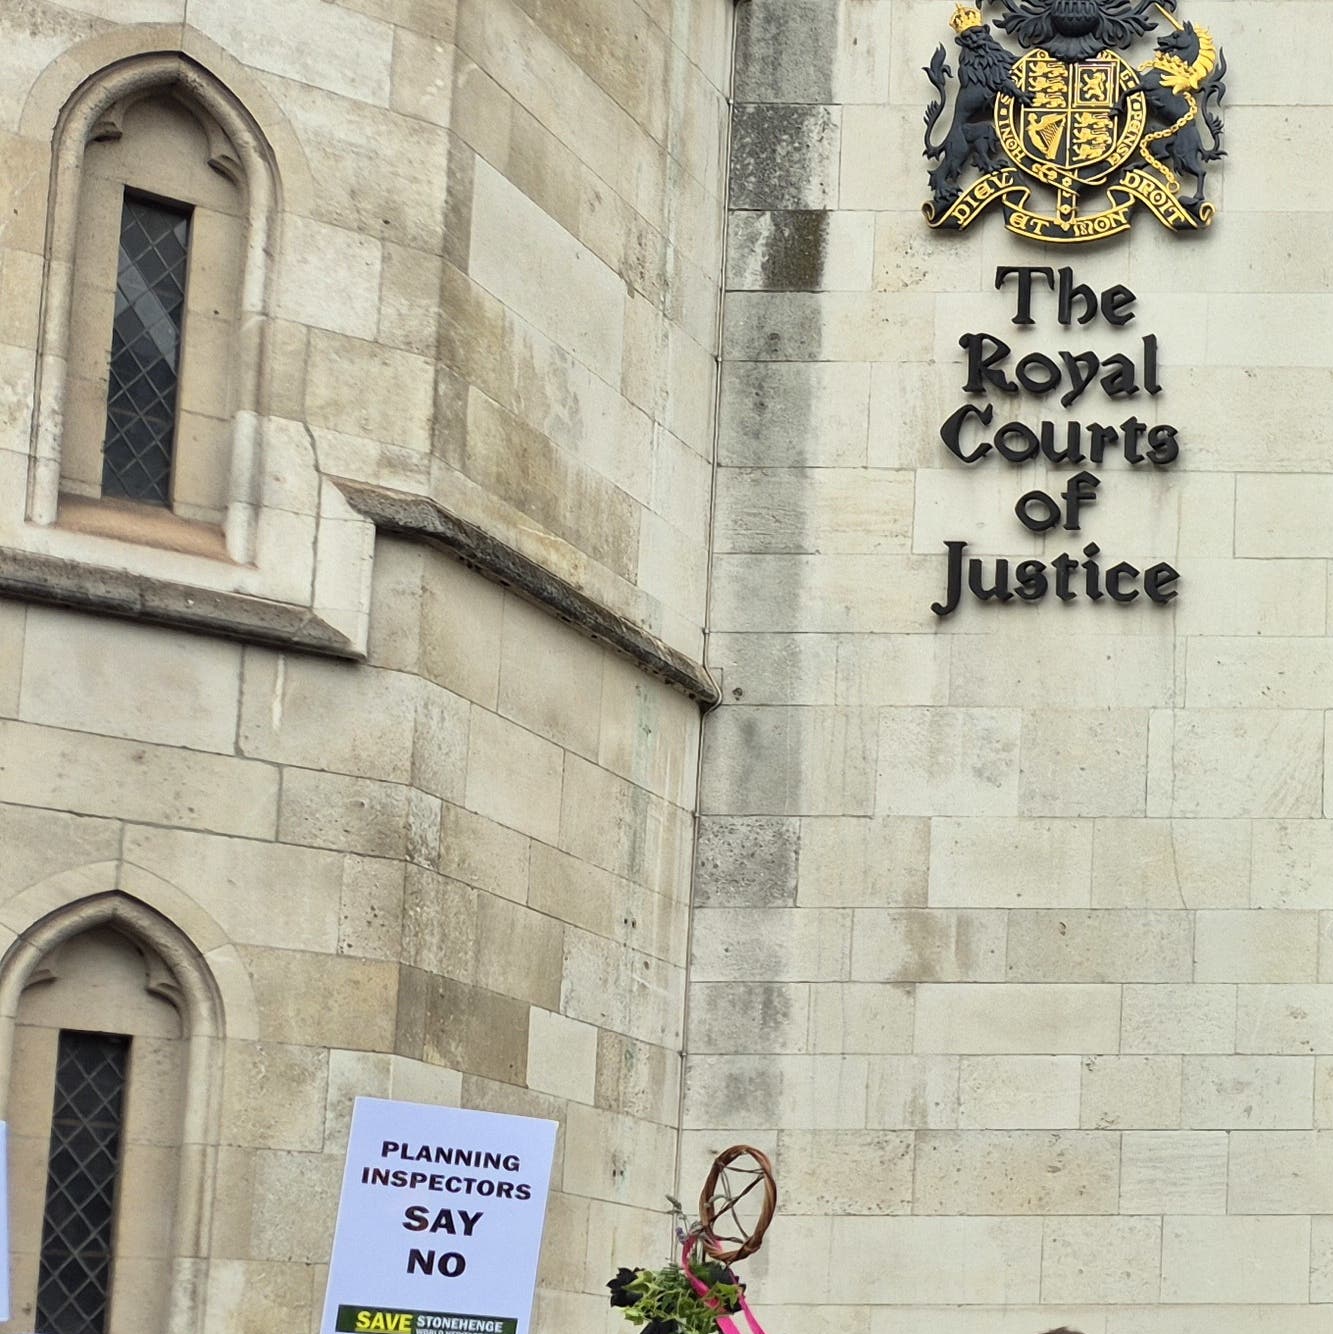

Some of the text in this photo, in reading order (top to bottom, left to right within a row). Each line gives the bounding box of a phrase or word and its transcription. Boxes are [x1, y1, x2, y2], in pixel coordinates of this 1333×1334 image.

[1119, 172, 1188, 225] DROIT
[995, 266, 1136, 325] The
[958, 333, 1162, 407] Royal
[940, 403, 1179, 465] Courts
[1015, 470, 1100, 531] of
[931, 540, 1180, 616] Justice
[381, 1140, 521, 1172] PLANNING
[361, 1167, 532, 1200] INSPECTORS
[402, 1205, 483, 1237] SAY
[406, 1248, 466, 1278] NO
[355, 1310, 504, 1334] SAVE STONEHENGE
